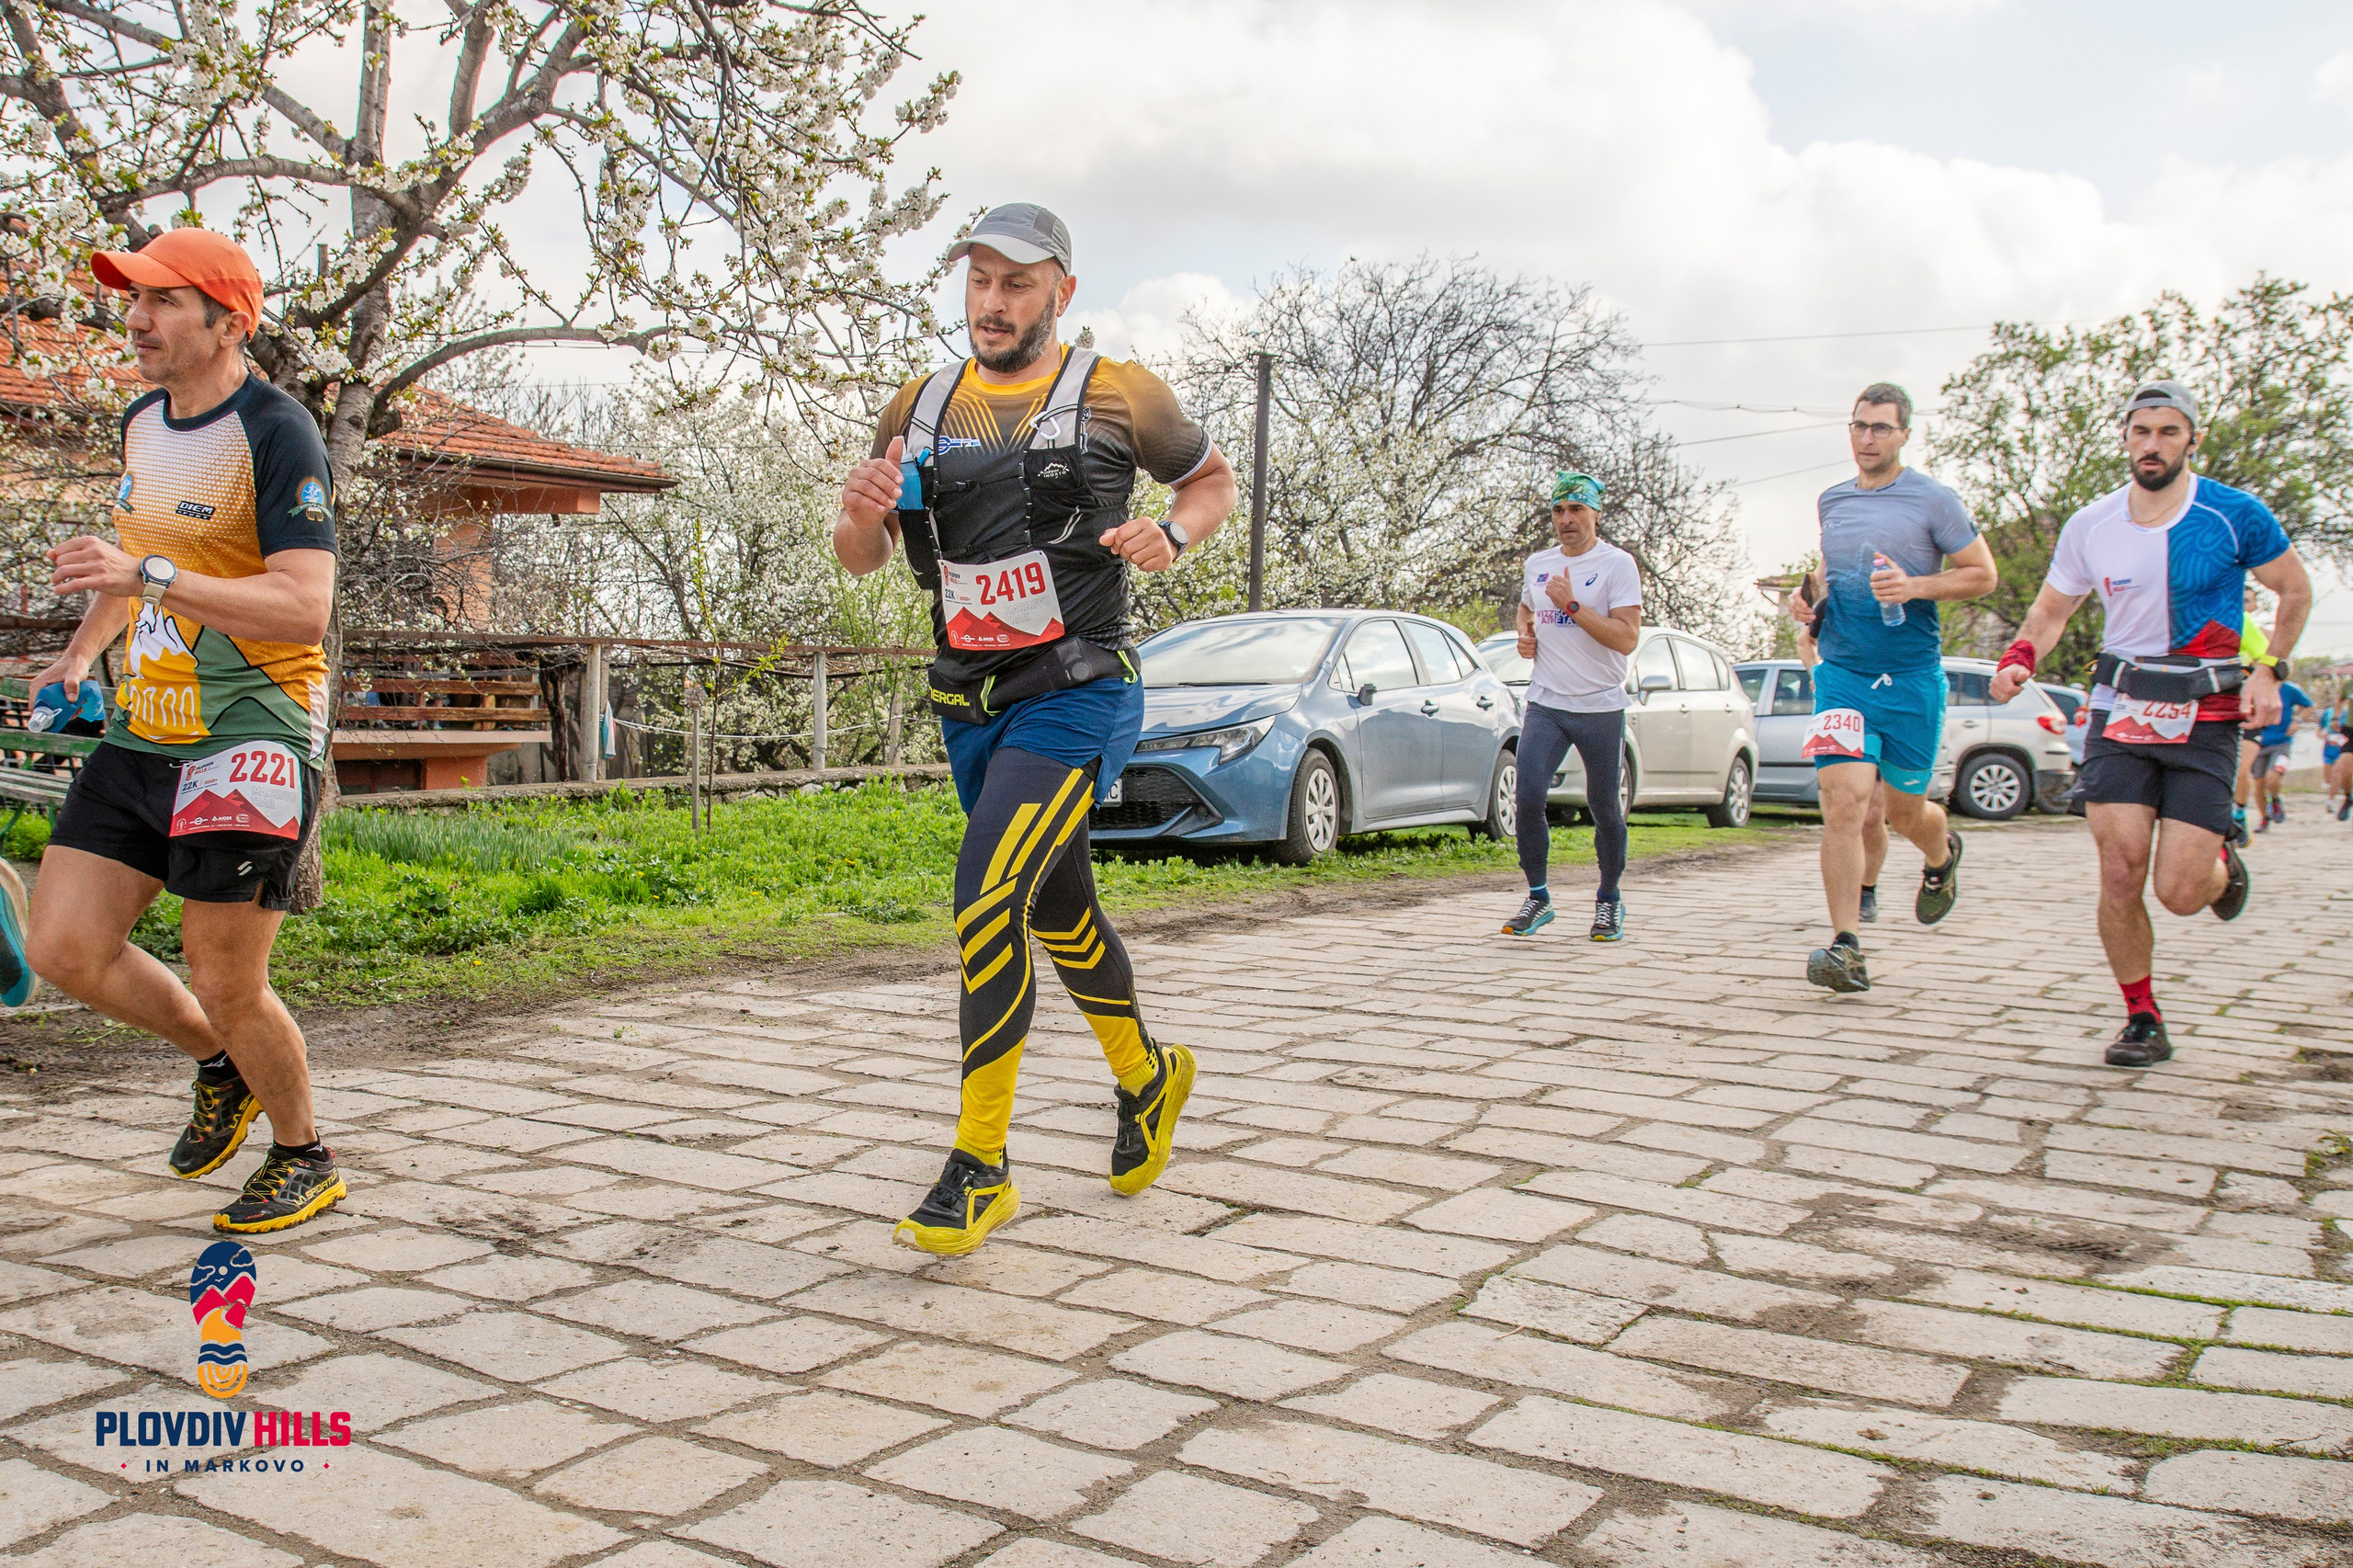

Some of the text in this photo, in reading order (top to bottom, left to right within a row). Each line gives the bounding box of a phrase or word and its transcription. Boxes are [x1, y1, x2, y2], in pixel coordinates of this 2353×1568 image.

[179, 502, 214, 515] DIEM
[975, 562, 1046, 606] 2419
[1004, 596, 1051, 615] MARKOVO
[1824, 713, 1861, 733] 2340
[229, 750, 296, 790] 2221
[182, 780, 199, 791] 22K
[251, 786, 297, 803] MARKOVO
[250, 796, 277, 810] TRAIL
